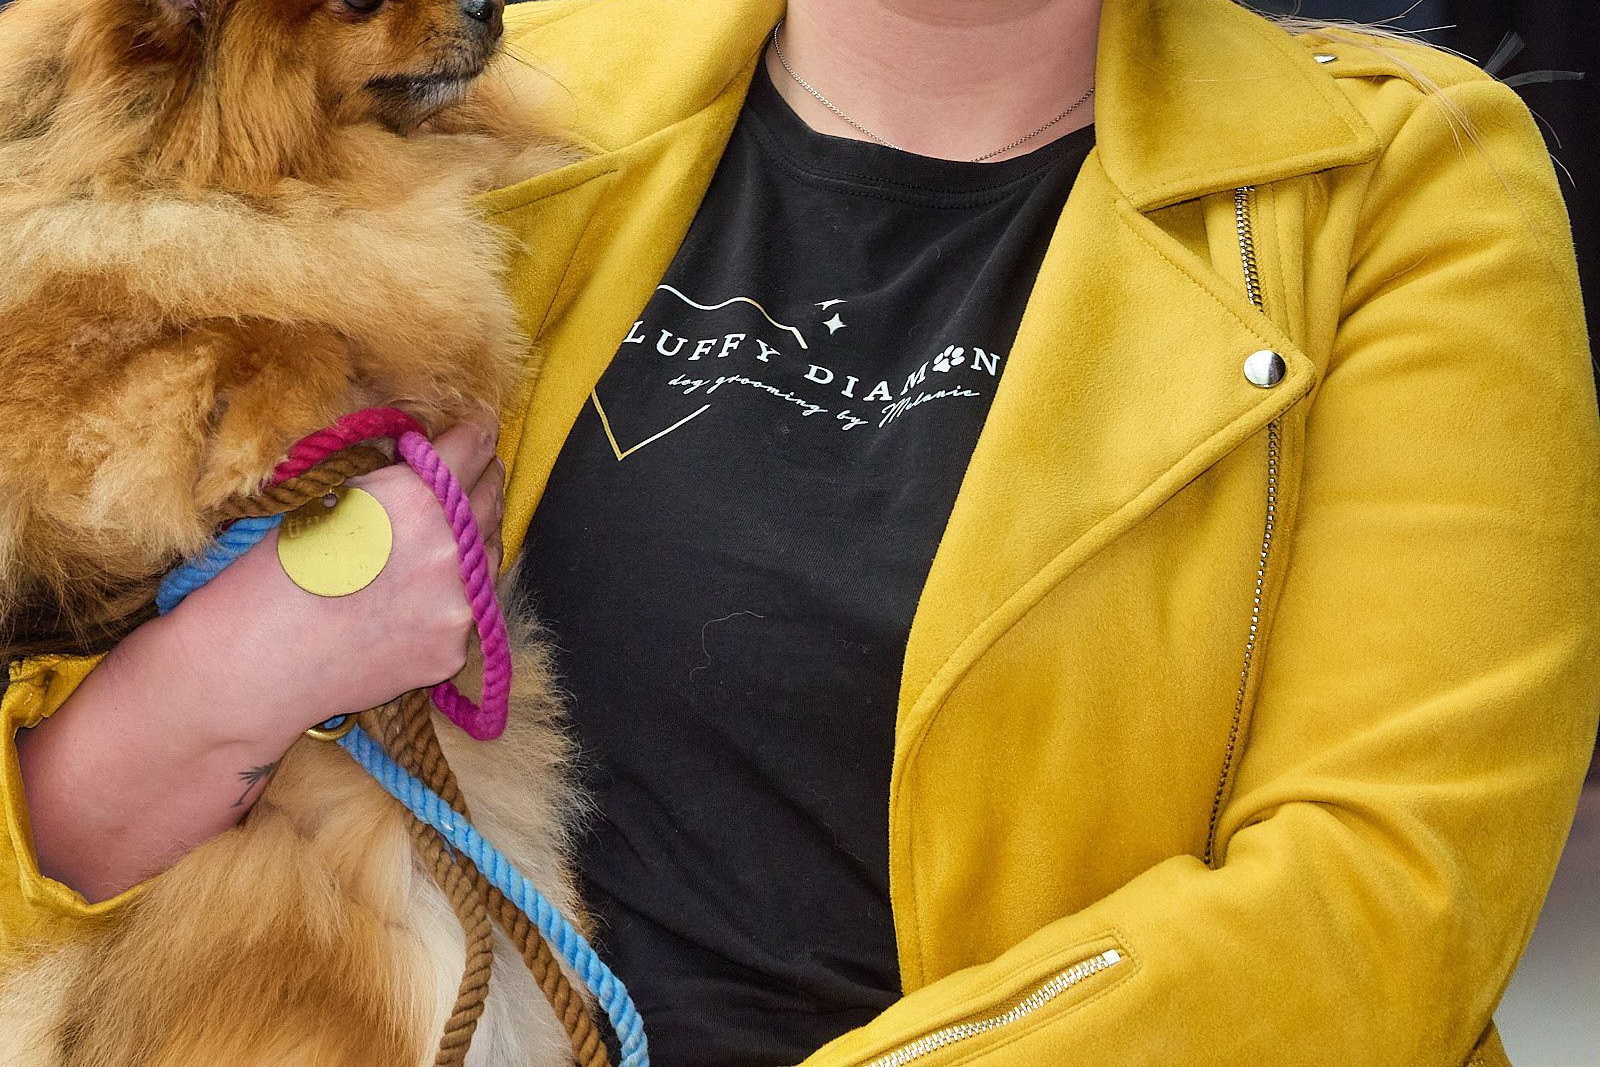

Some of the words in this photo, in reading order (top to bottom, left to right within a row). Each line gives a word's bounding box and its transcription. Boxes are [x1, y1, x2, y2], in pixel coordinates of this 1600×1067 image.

[667, 373, 710, 395] dog
[706, 374, 829, 417] grooming
[836, 409, 869, 431] by
[878, 384, 981, 429] Melanie
